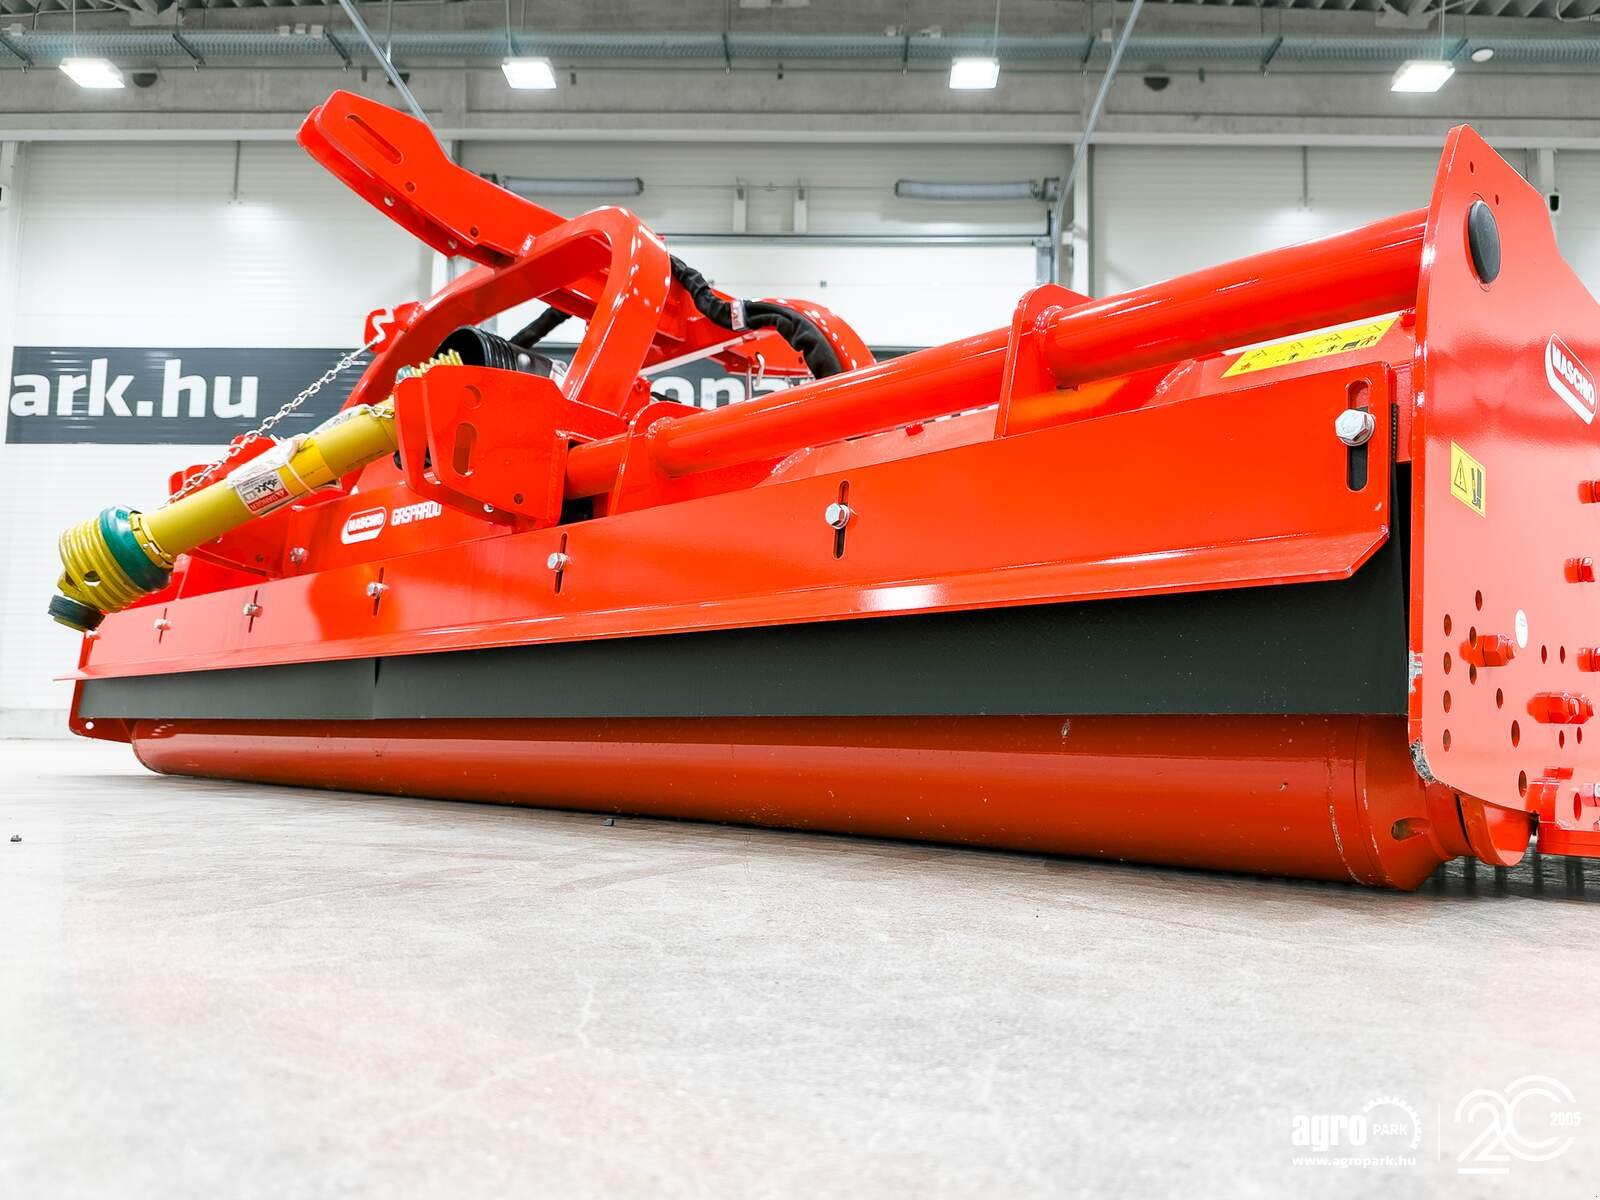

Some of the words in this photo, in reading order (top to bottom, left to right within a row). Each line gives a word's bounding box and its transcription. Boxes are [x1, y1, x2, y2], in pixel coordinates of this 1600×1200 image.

[10, 358, 259, 418] ark.hu
[1551, 343, 1595, 406] MASCHIO
[347, 512, 385, 532] MASCHIO
